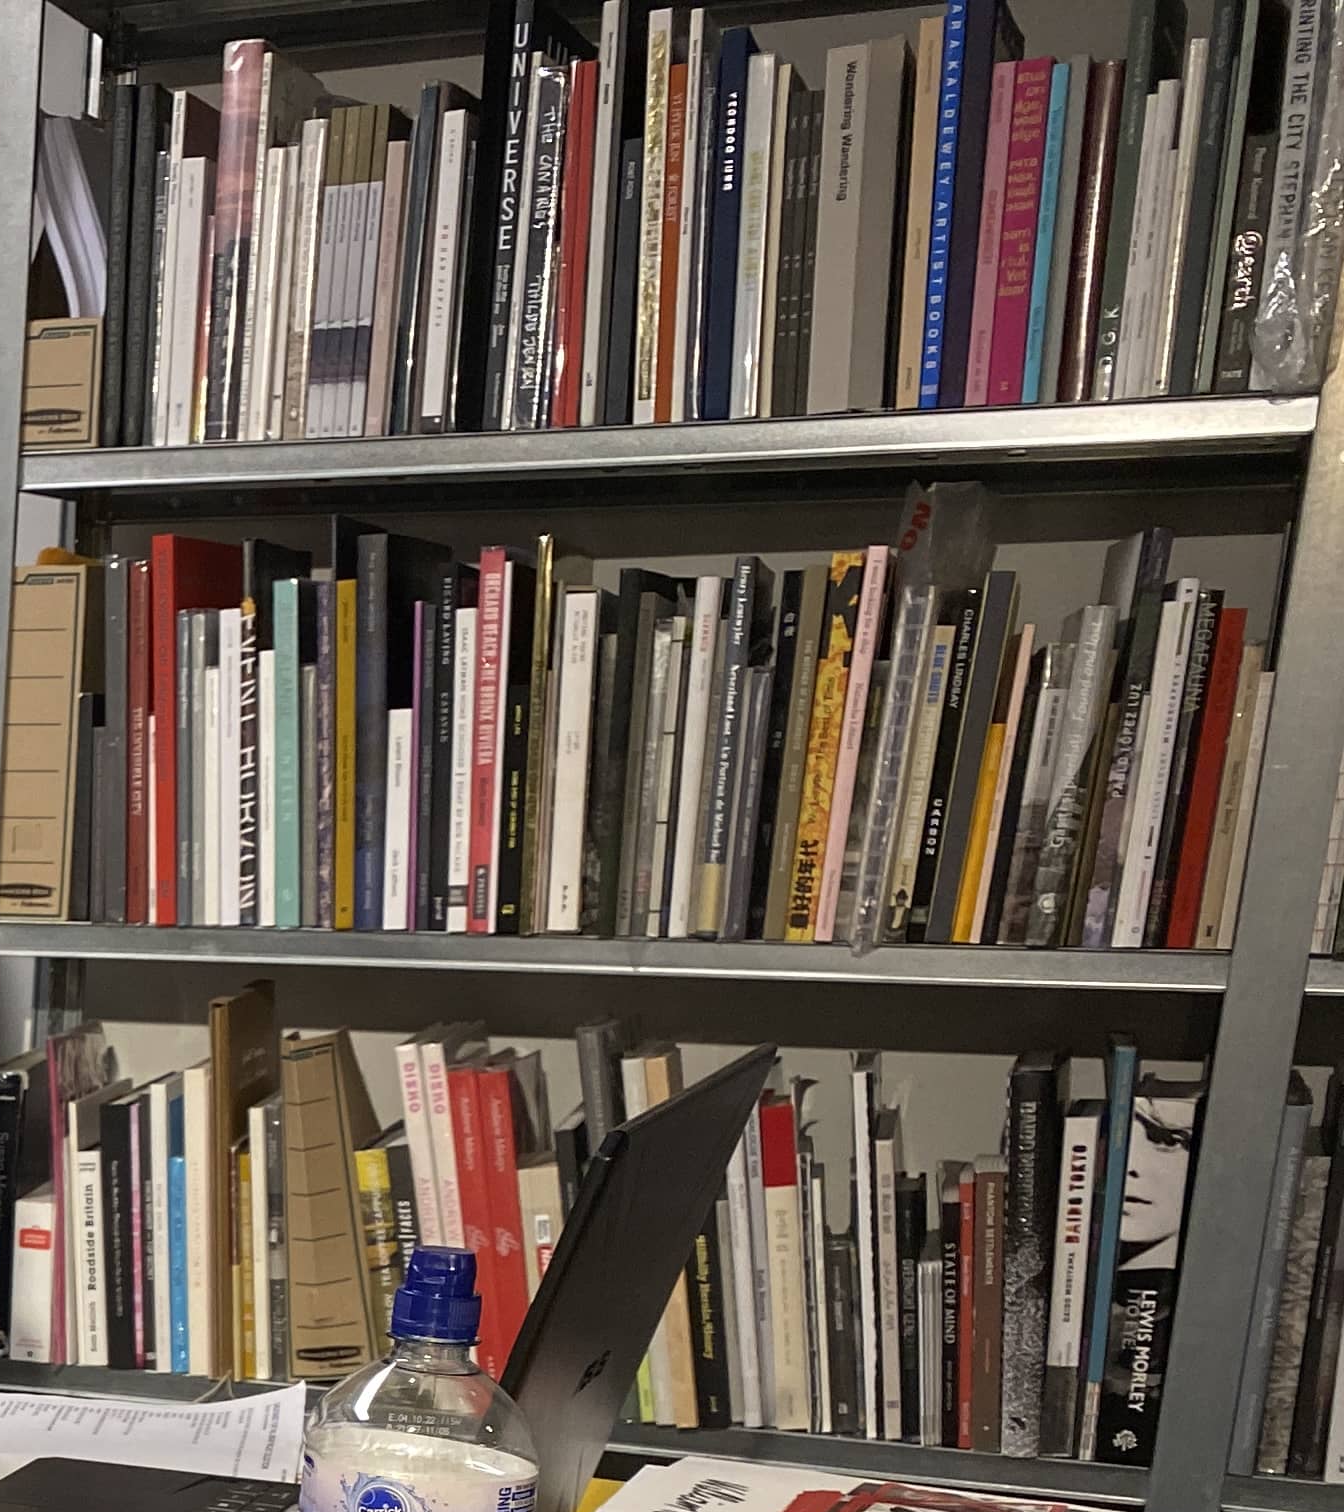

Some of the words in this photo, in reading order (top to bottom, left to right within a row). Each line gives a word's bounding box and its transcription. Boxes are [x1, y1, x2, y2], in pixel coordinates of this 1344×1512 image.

[840, 61, 858, 130] Wandering
[1290, 72, 1310, 105] THE
[498, 22, 529, 250] UNIVERSE
[540, 106, 557, 144] THE
[1285, 113, 1305, 151] CITY
[836, 134, 854, 202] Wandering
[482, 572, 501, 620] ORCHARD
[737, 565, 751, 594] Henry
[482, 623, 499, 658] BEACH
[955, 609, 974, 660] CHARLES
[1085, 621, 1102, 648] lost
[480, 662, 497, 682] THE
[1080, 650, 1099, 677] and
[1183, 602, 1218, 713] MEGAFAUNA
[479, 685, 496, 721] BRONX
[948, 662, 966, 709] LINDSAY
[1074, 677, 1094, 722] Found
[477, 724, 494, 766] RIVIERA
[723, 715, 735, 736] Lost
[1112, 757, 1129, 799] PABLO
[1125, 683, 1142, 707] LUZ
[717, 761, 729, 798] Portrait
[715, 799, 724, 810] de
[712, 813, 724, 847] Michael
[1067, 1145, 1088, 1191] TOKYO
[83, 1184, 95, 1227] Britain
[443, 1179, 462, 1242] ANDREW
[985, 1182, 996, 1226] PHANTOM
[1063, 1197, 1083, 1244] DAIDO
[86, 1231, 97, 1291] Roadside
[944, 1242, 957, 1287] STATE
[984, 1228, 995, 1286] SETTLEMENTS
[944, 1288, 956, 1303] OF
[1137, 1289, 1159, 1342] LEWIS
[944, 1305, 956, 1344] MIND
[1127, 1346, 1153, 1413] MORLEY
